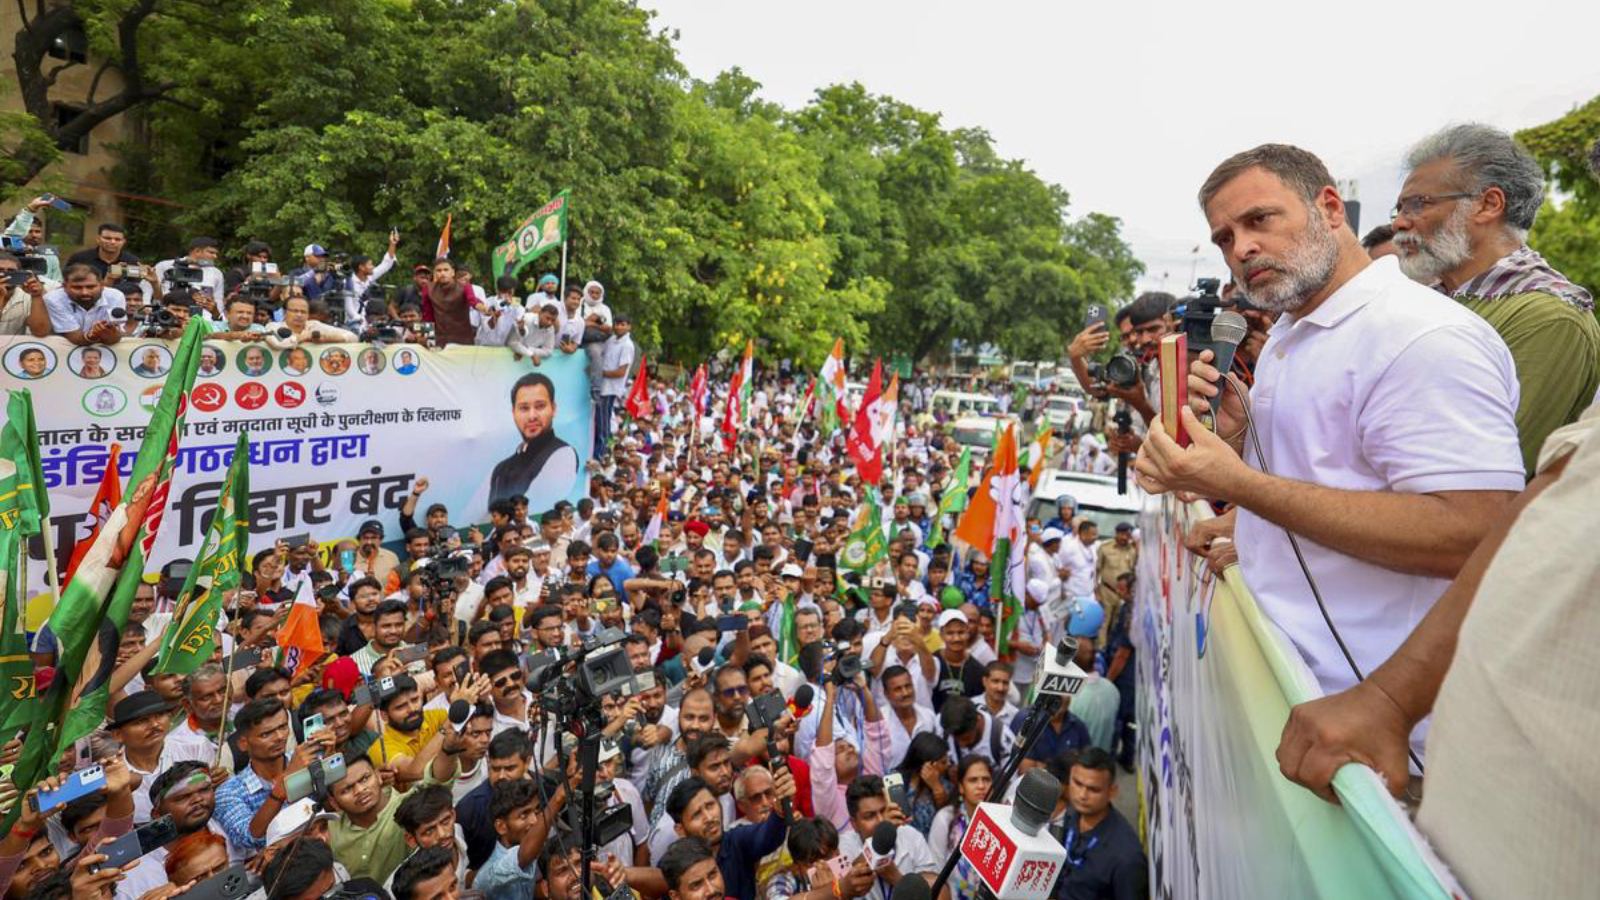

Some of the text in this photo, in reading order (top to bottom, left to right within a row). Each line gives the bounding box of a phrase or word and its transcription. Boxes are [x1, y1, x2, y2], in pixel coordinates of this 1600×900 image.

[87, 423, 110, 442] के
[194, 418, 219, 436] एवं
[222, 417, 283, 433] मतदाता
[286, 411, 318, 433] सूची
[320, 412, 336, 428] के
[338, 409, 399, 431] पुनरीक्षण
[401, 408, 414, 423] के
[416, 406, 462, 423] खिलाफ
[308, 434, 370, 467] द्वारा
[1043, 676, 1082, 692] ANI
